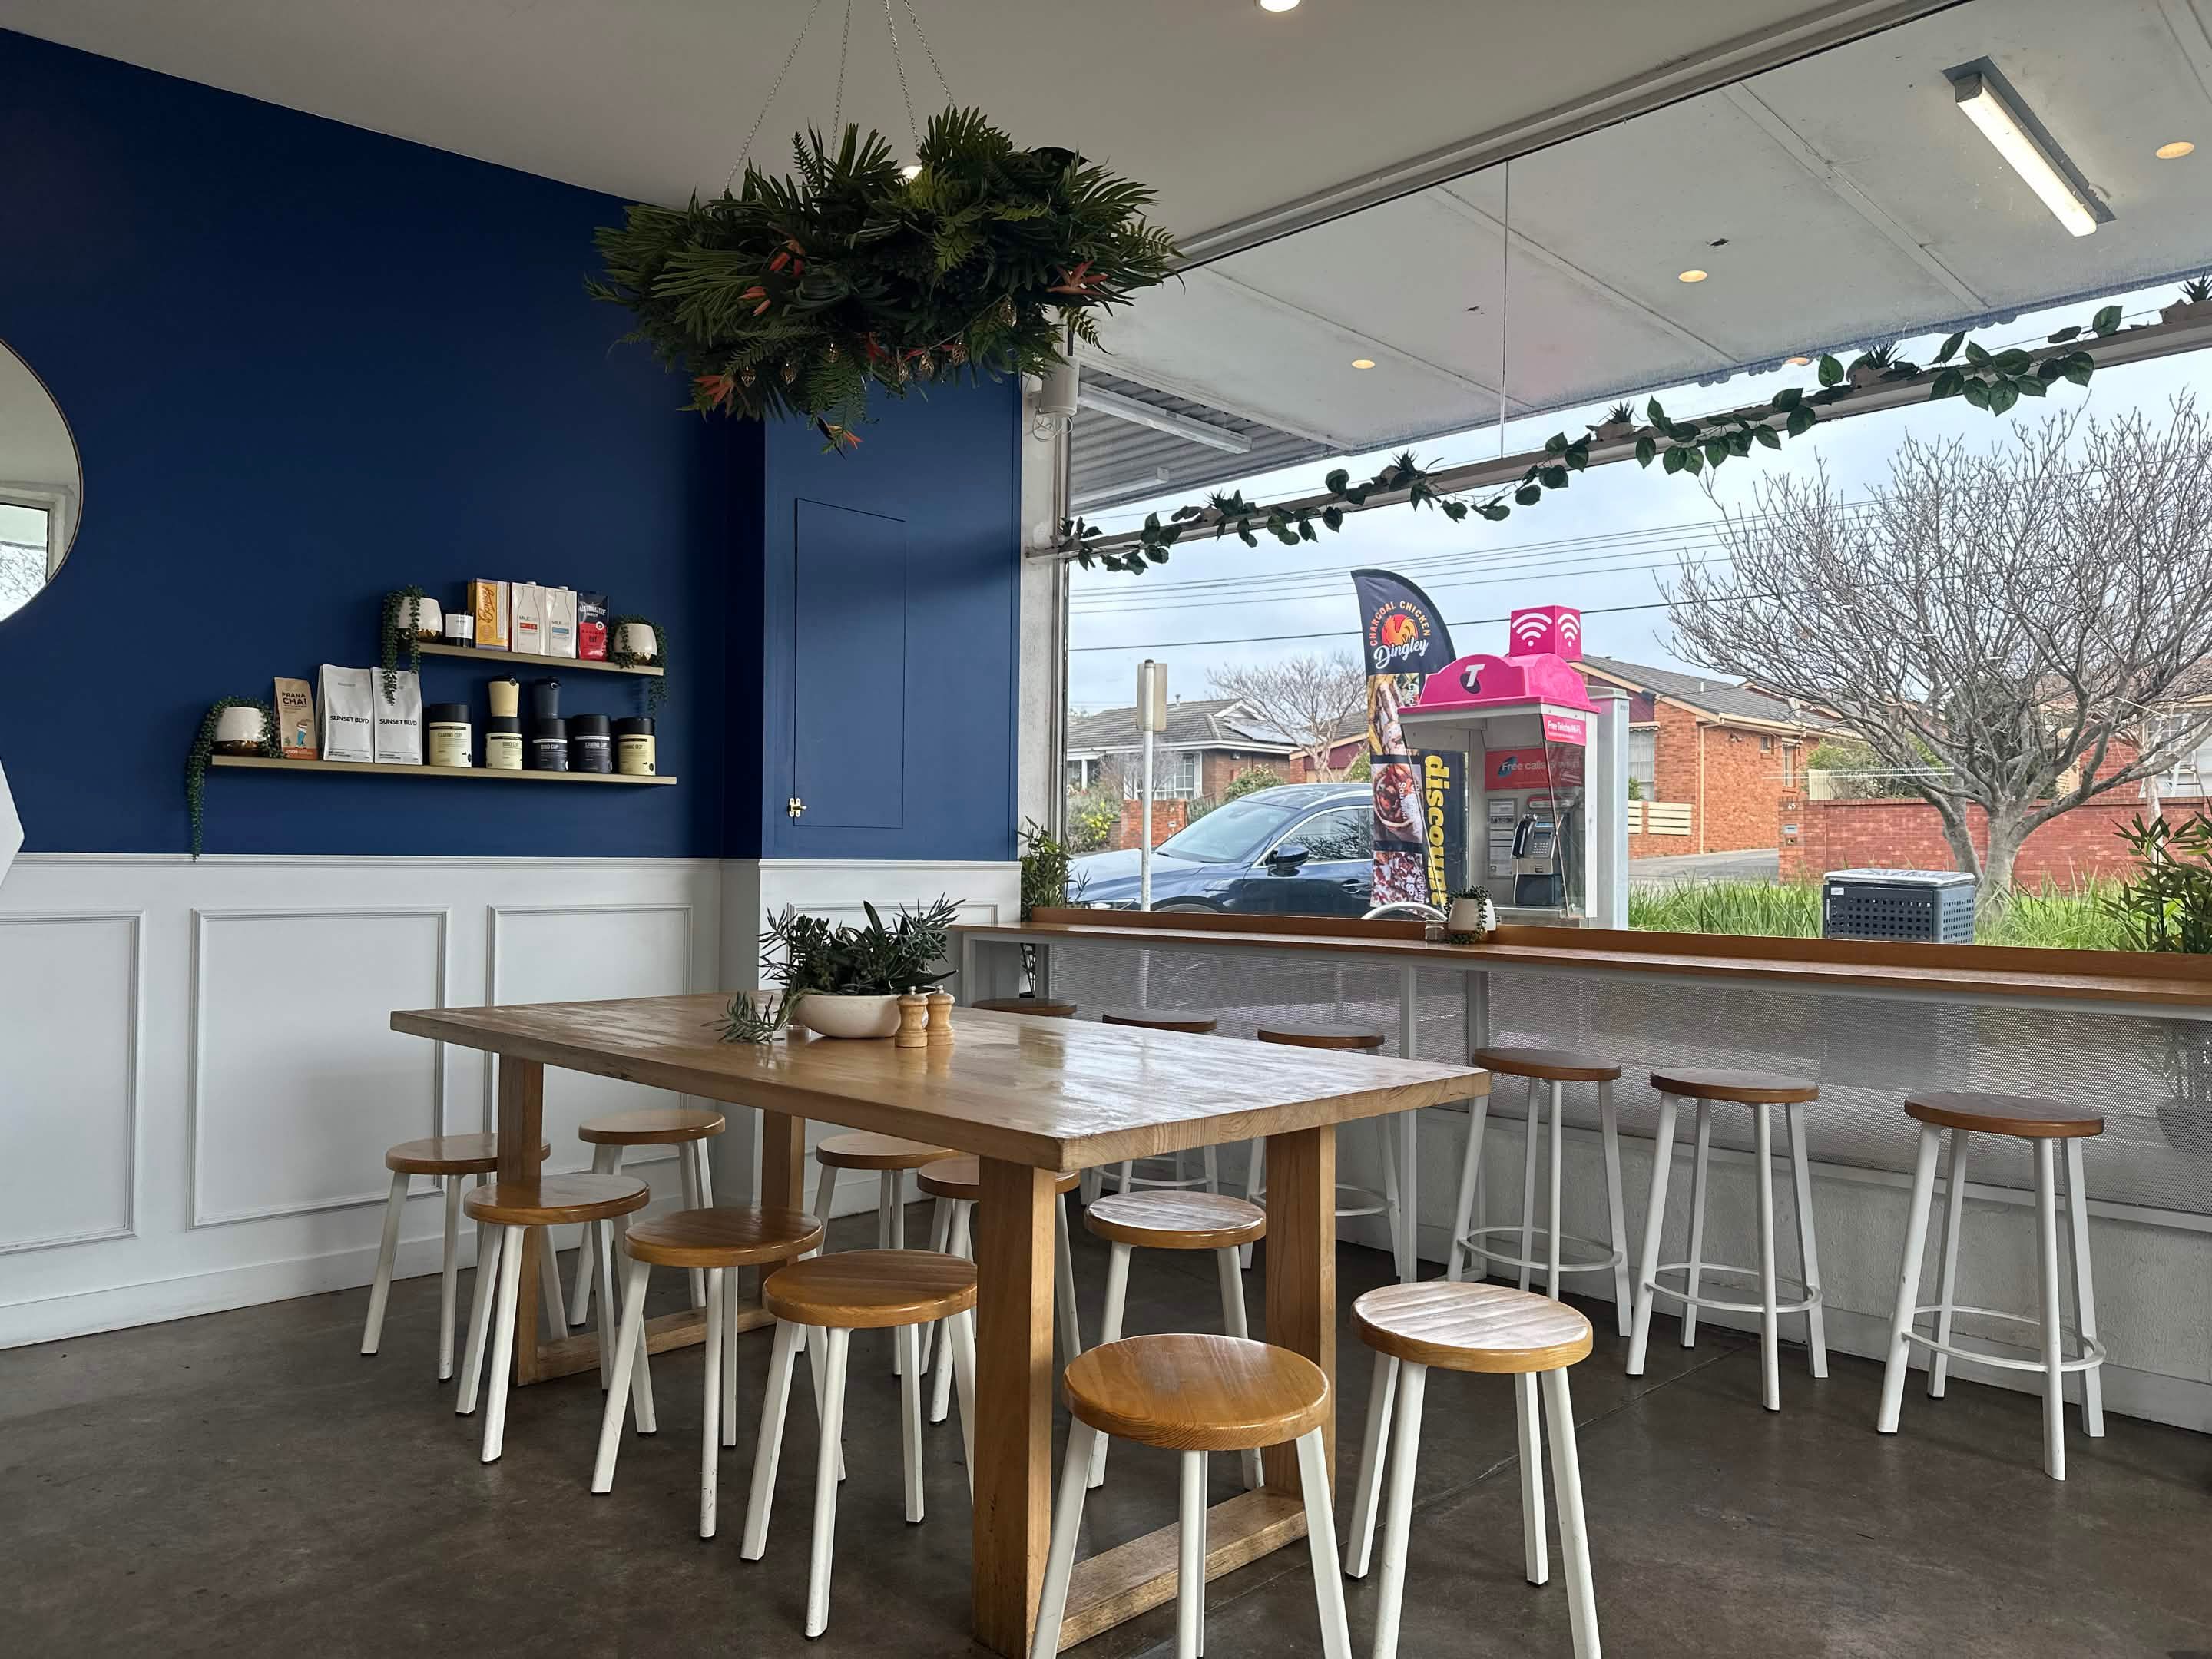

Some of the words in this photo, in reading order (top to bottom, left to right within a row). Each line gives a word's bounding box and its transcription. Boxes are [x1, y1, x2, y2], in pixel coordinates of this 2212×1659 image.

[1369, 601, 1396, 647] CHARCOAL
[1399, 601, 1432, 637] CHICKEN
[1373, 637, 1429, 670] Dingley
[1465, 664, 1485, 687] T
[329, 715, 354, 724] SUNSET
[354, 716, 369, 724] BLVD
[1502, 761, 1523, 771] Free
[1524, 760, 1546, 770] calls
[1425, 755, 1450, 906] discount
